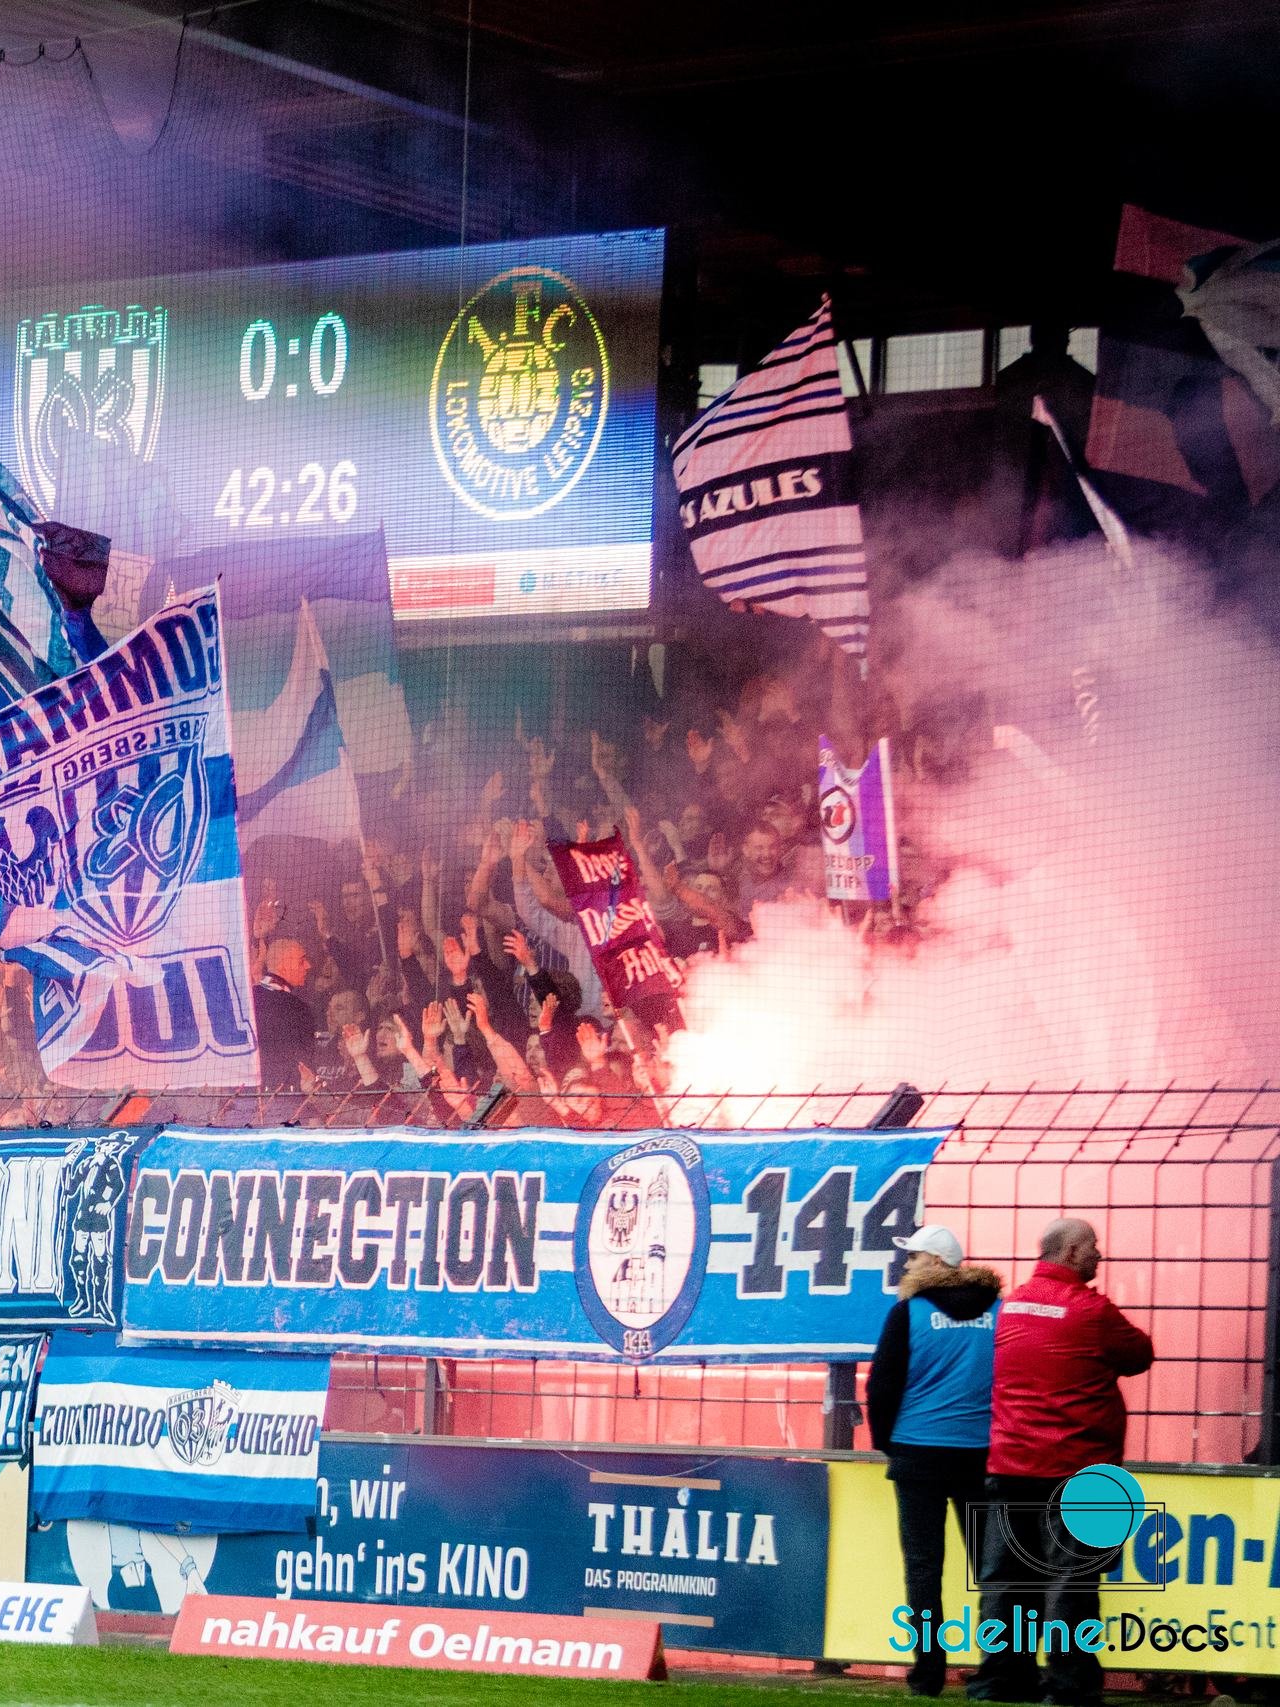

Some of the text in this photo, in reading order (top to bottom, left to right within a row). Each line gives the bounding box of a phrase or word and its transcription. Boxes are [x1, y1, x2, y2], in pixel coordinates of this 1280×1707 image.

[239, 310, 349, 401] 0:0
[445, 365, 597, 500] LOKOMOTIVE LEIPZIG
[213, 459, 360, 528] 42:26
[699, 467, 822, 523] AZULES
[126, 1165, 926, 1300] CONNECTION 144
[38, 1404, 318, 1457] COMMANDO JUGEND
[350, 1464, 406, 1521] wir
[375, 1539, 427, 1596] ins
[437, 1542, 529, 1600] KINO
[584, 1568, 717, 1597] DAS PROGRAMMKINO
[199, 1611, 623, 1671] nahkauf Oelmann
